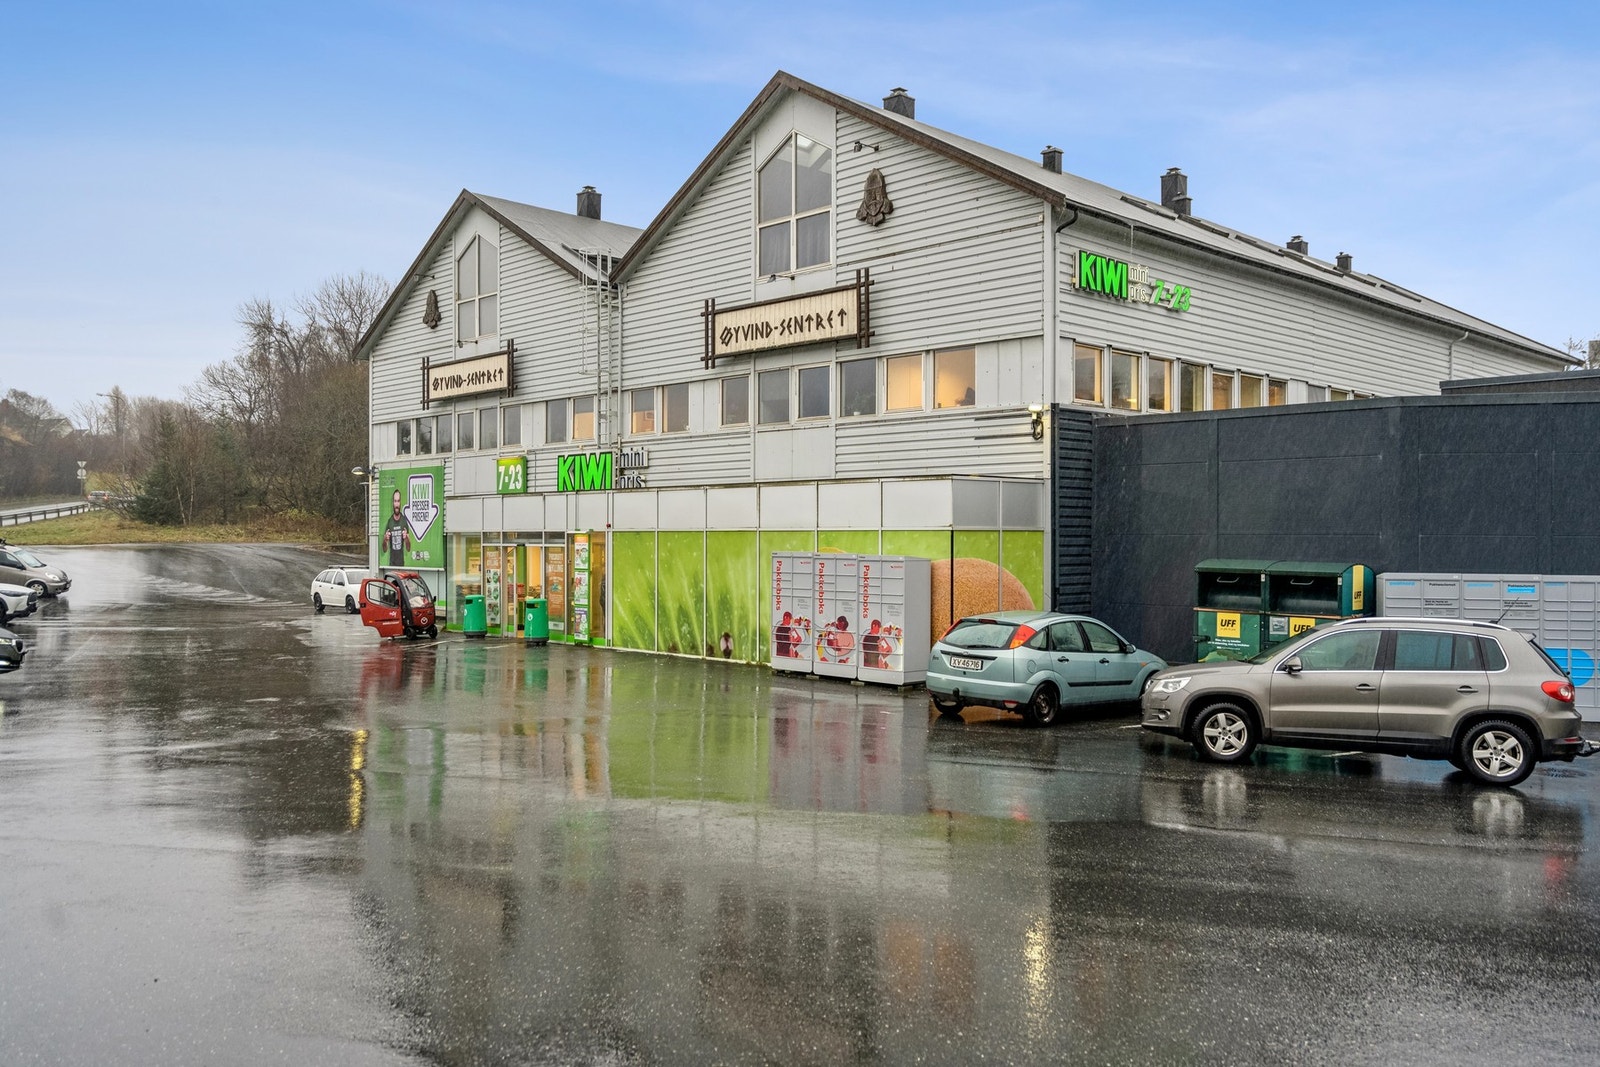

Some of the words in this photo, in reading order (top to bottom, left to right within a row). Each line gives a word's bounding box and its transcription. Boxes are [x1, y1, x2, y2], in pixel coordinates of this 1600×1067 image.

[1079, 250, 1128, 299] KIWI
[1129, 264, 1149, 283] mini
[1129, 284, 1147, 303] pris
[1154, 280, 1191, 312] 7-23
[620, 447, 645, 466] mini
[498, 464, 522, 490] 7-23
[558, 452, 613, 491] KIWI
[412, 484, 429, 499] KIWI
[412, 500, 430, 511] PRESSER
[1354, 591, 1362, 599] UFF
[1220, 619, 1237, 627] UFF
